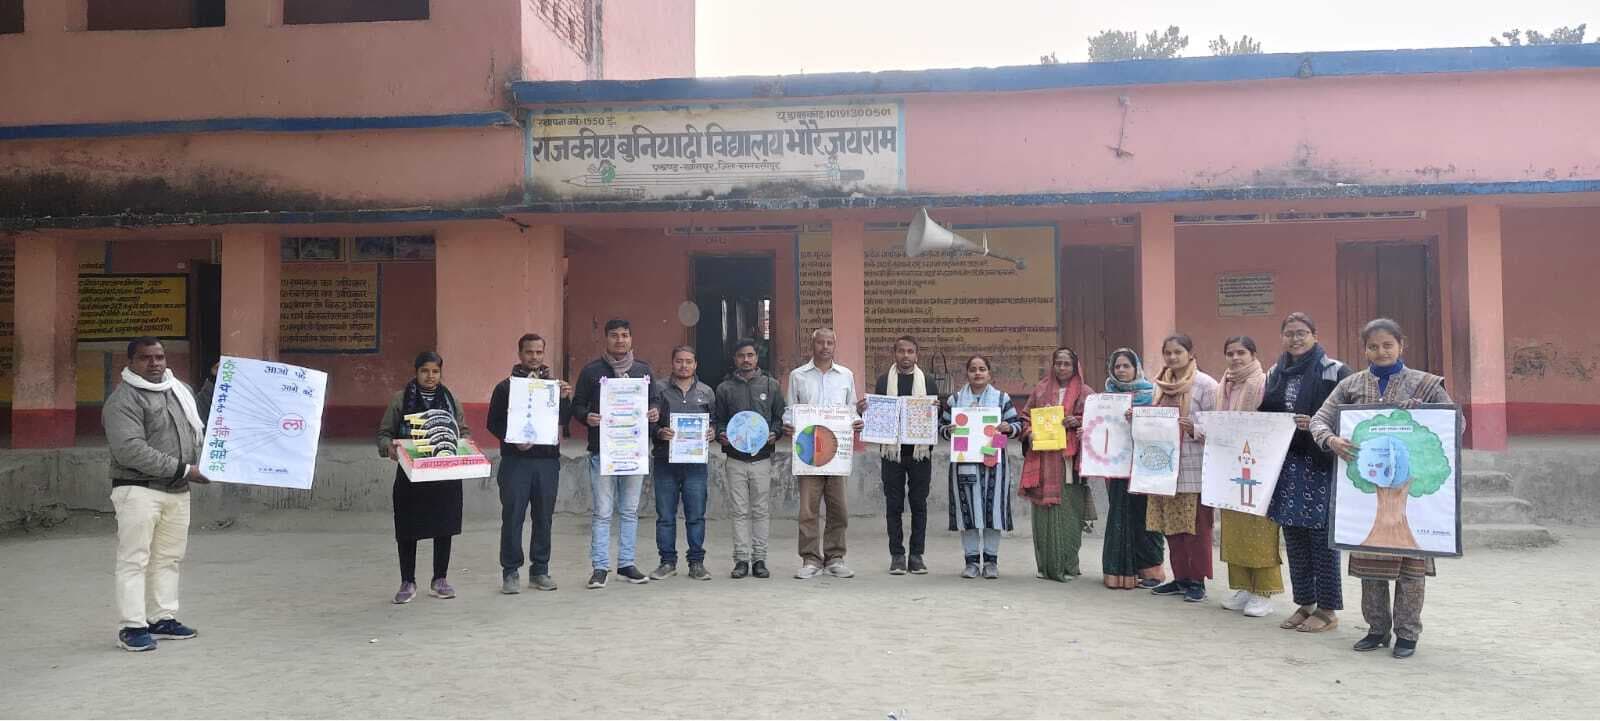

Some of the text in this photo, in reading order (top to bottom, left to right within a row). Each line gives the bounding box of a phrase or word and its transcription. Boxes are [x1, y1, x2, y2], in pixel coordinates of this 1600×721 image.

[533, 127, 617, 162] राजकीय
[617, 124, 703, 163] बुनियादी
[705, 122, 784, 160] विद्यालय
